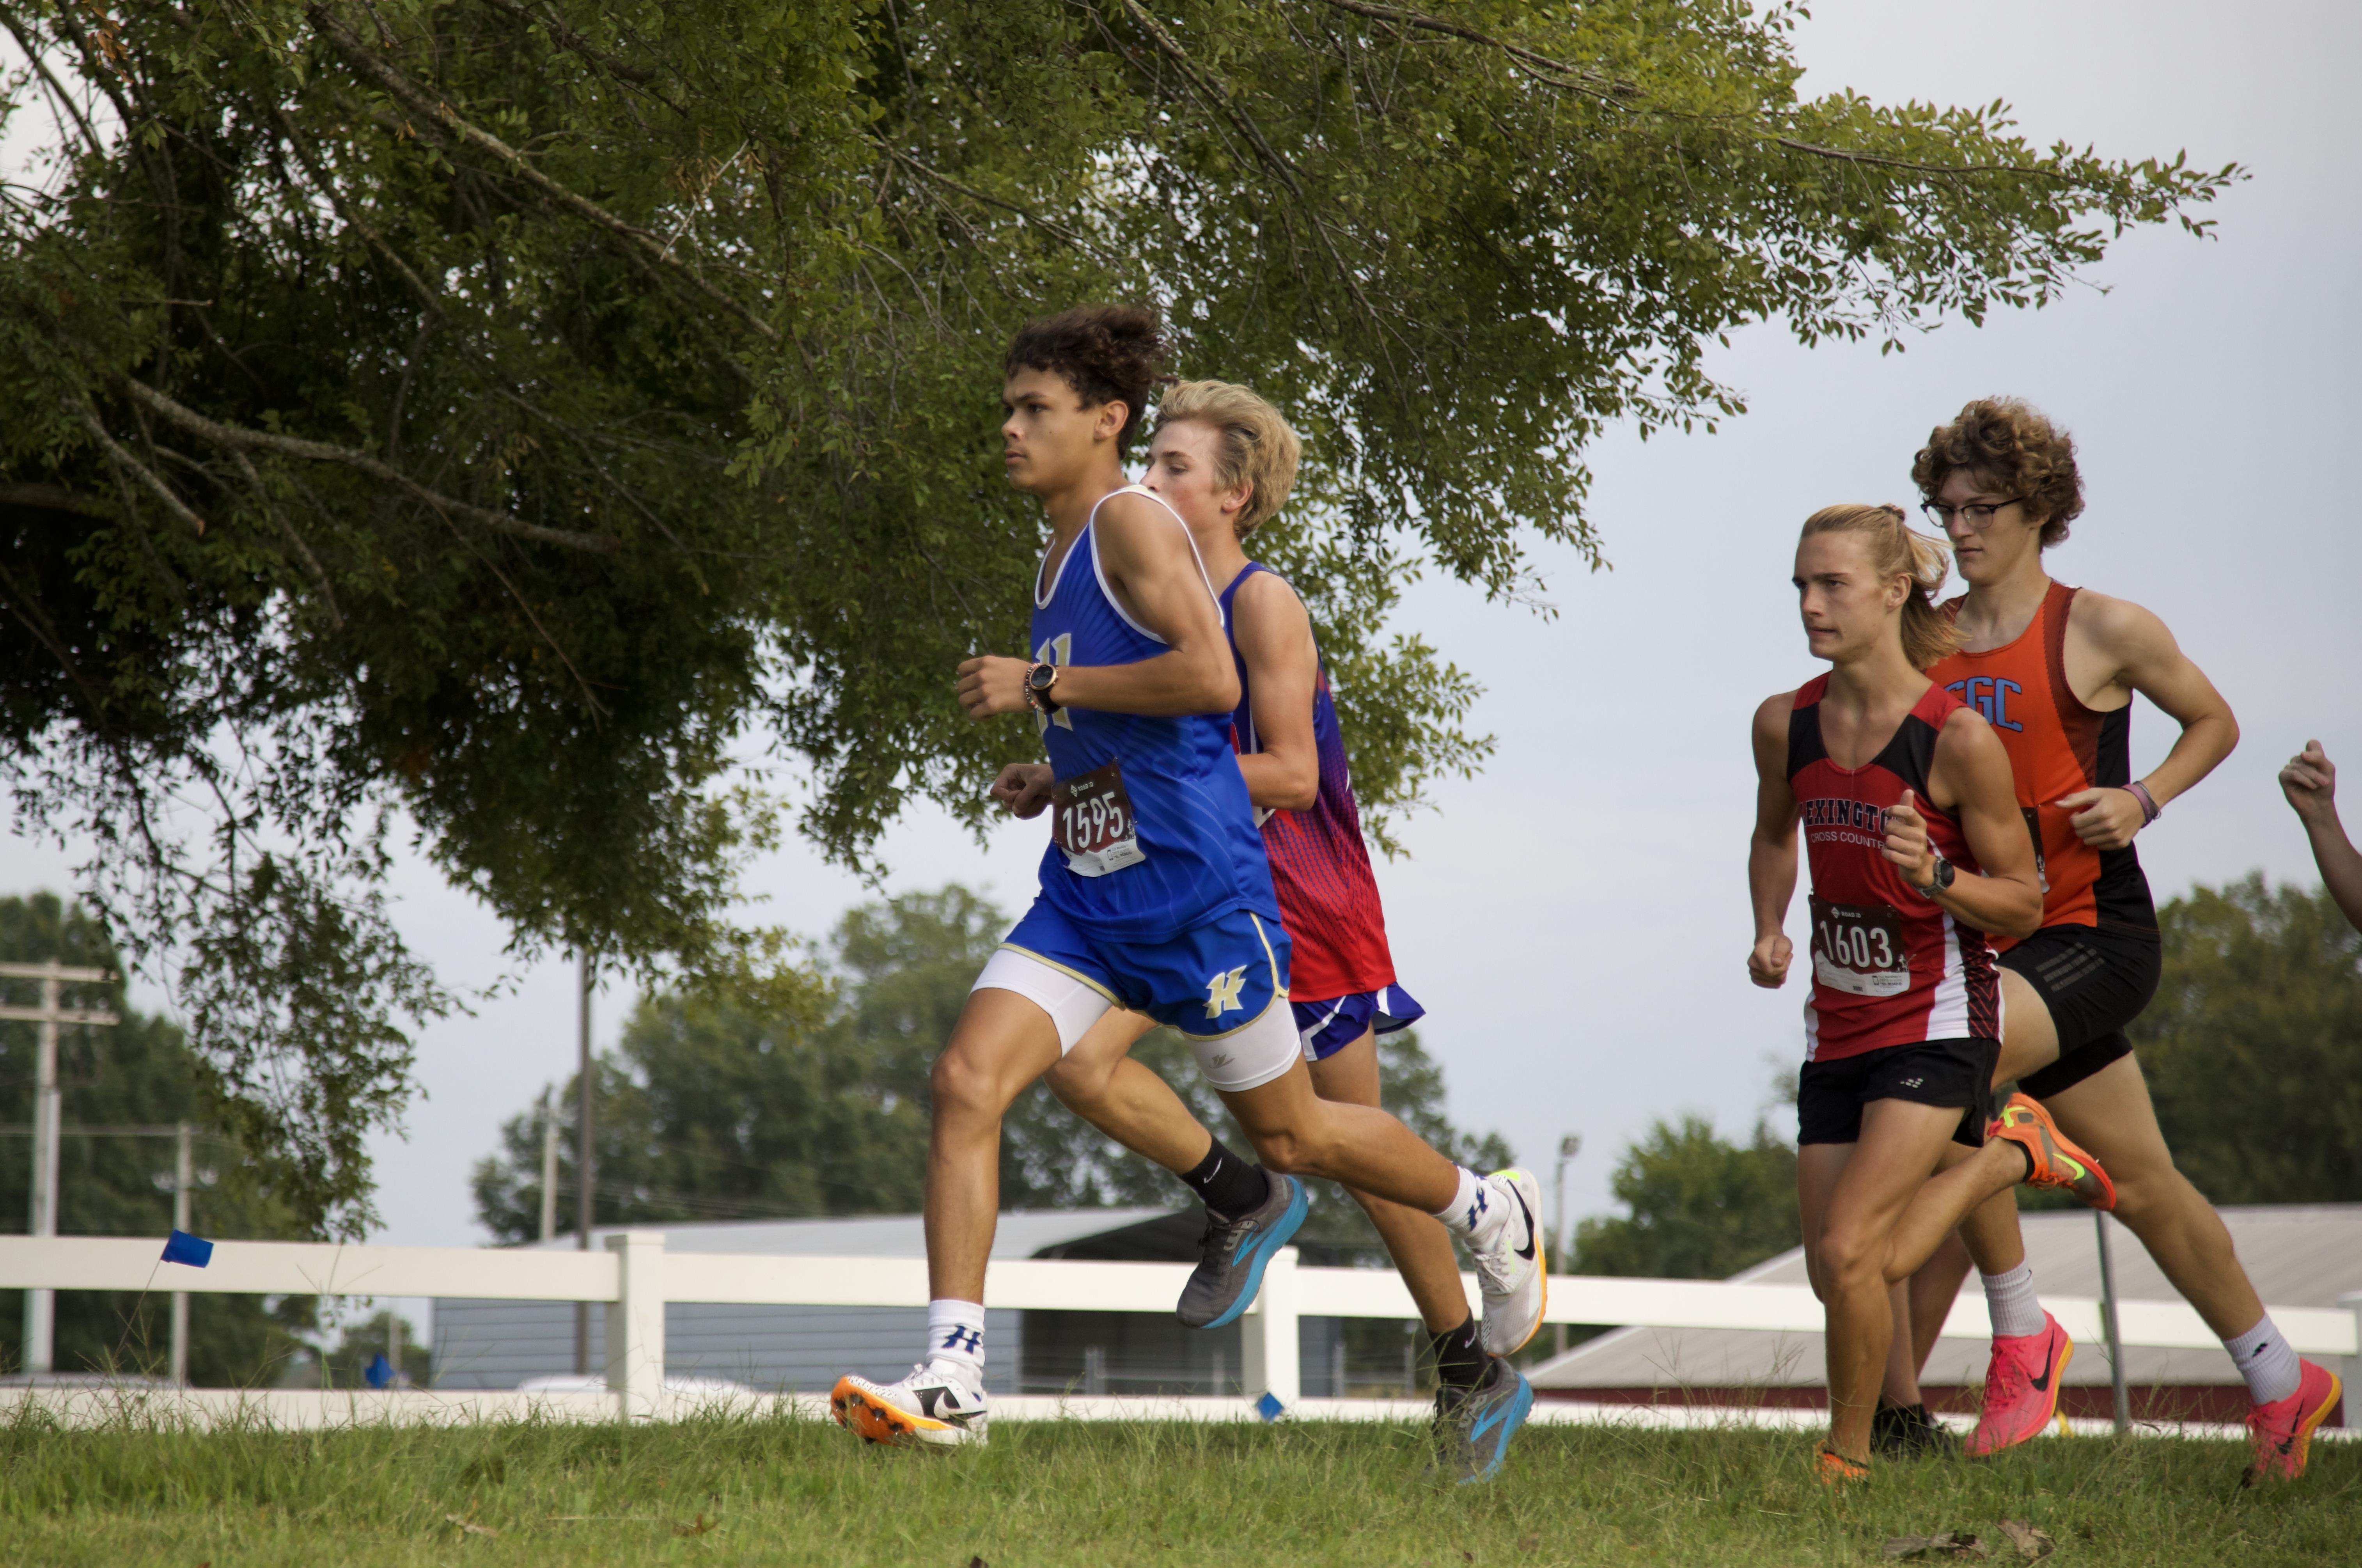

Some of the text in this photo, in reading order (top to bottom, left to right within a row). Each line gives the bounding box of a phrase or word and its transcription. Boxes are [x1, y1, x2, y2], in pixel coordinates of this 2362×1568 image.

[1944, 676, 2023, 733] GC
[1063, 791, 1123, 851] 1595
[1811, 831, 1837, 843] CROSS
[1820, 921, 1893, 968] 1603
